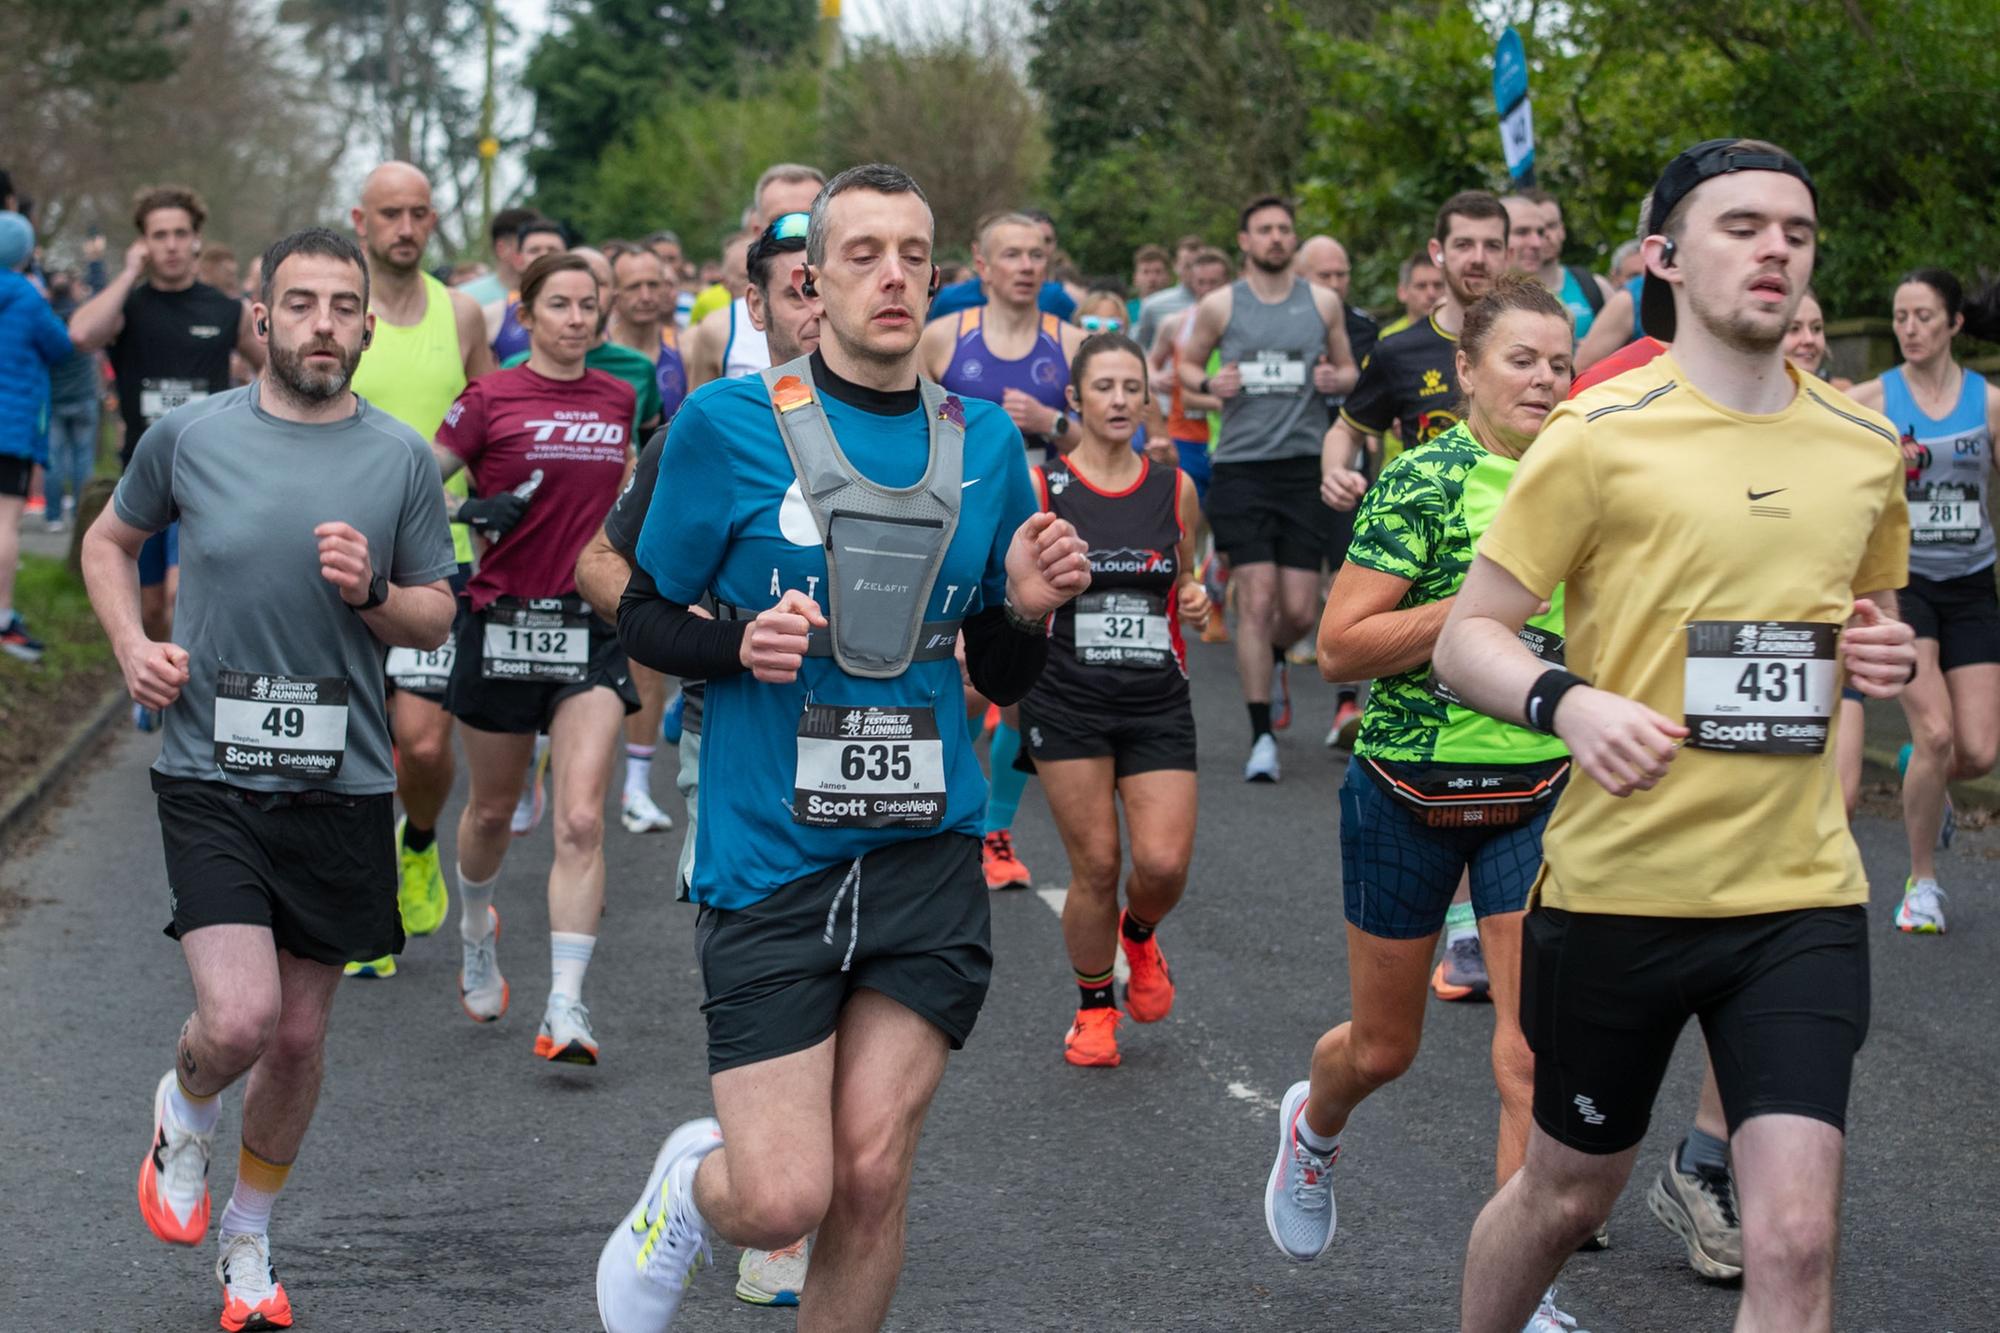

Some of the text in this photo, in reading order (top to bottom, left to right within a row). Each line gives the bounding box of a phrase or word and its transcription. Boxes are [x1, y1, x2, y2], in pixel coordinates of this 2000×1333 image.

[554, 411, 599, 420] QATAR
[1929, 505, 1961, 522] 281
[1151, 560, 1172, 572] AC
[1104, 617, 1144, 639] 321
[507, 630, 567, 653] 1132
[1085, 648, 1122, 661] Scott
[493, 660, 531, 674] Scott
[1736, 662, 1807, 702] 431
[269, 690, 318, 700] RUNNING
[262, 707, 304, 738] 49
[806, 708, 836, 734] HM
[862, 724, 913, 735] RUNNING
[864, 717, 899, 725] FESTIVAL
[232, 734, 260, 744] Stephen
[1699, 720, 1767, 741] Scott
[225, 746, 273, 767] Scott
[279, 754, 336, 769] GlobeWeigh
[840, 744, 912, 781] 635
[819, 781, 920, 790] James M
[808, 795, 938, 816] Scott GlobeWeigh
